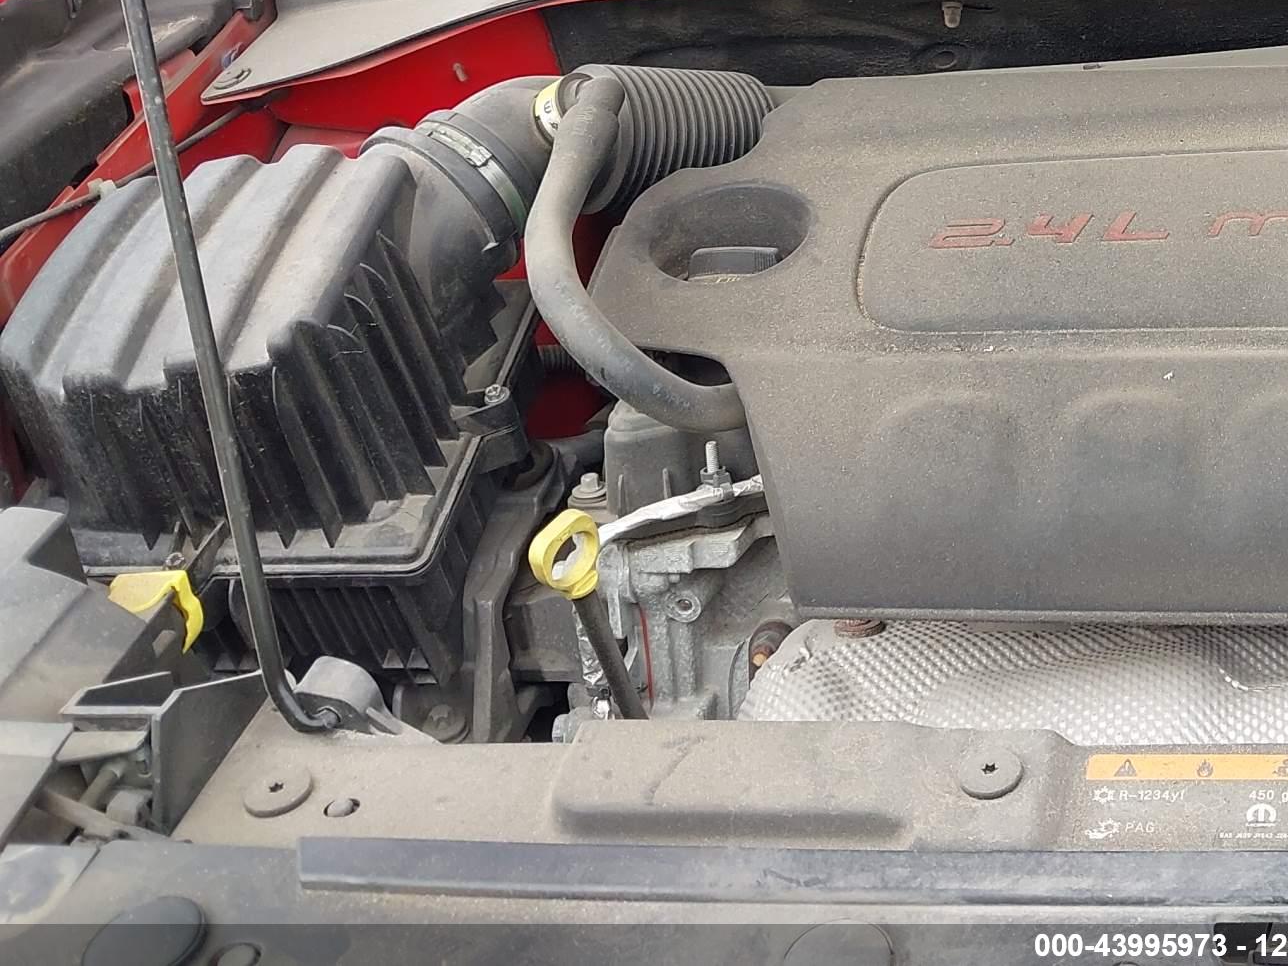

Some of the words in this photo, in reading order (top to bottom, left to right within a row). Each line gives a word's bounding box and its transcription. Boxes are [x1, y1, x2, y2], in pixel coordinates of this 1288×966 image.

[928, 211, 1170, 249] 2.4L
[1248, 789, 1275, 801] 450
[1124, 820, 1156, 833] PAG
